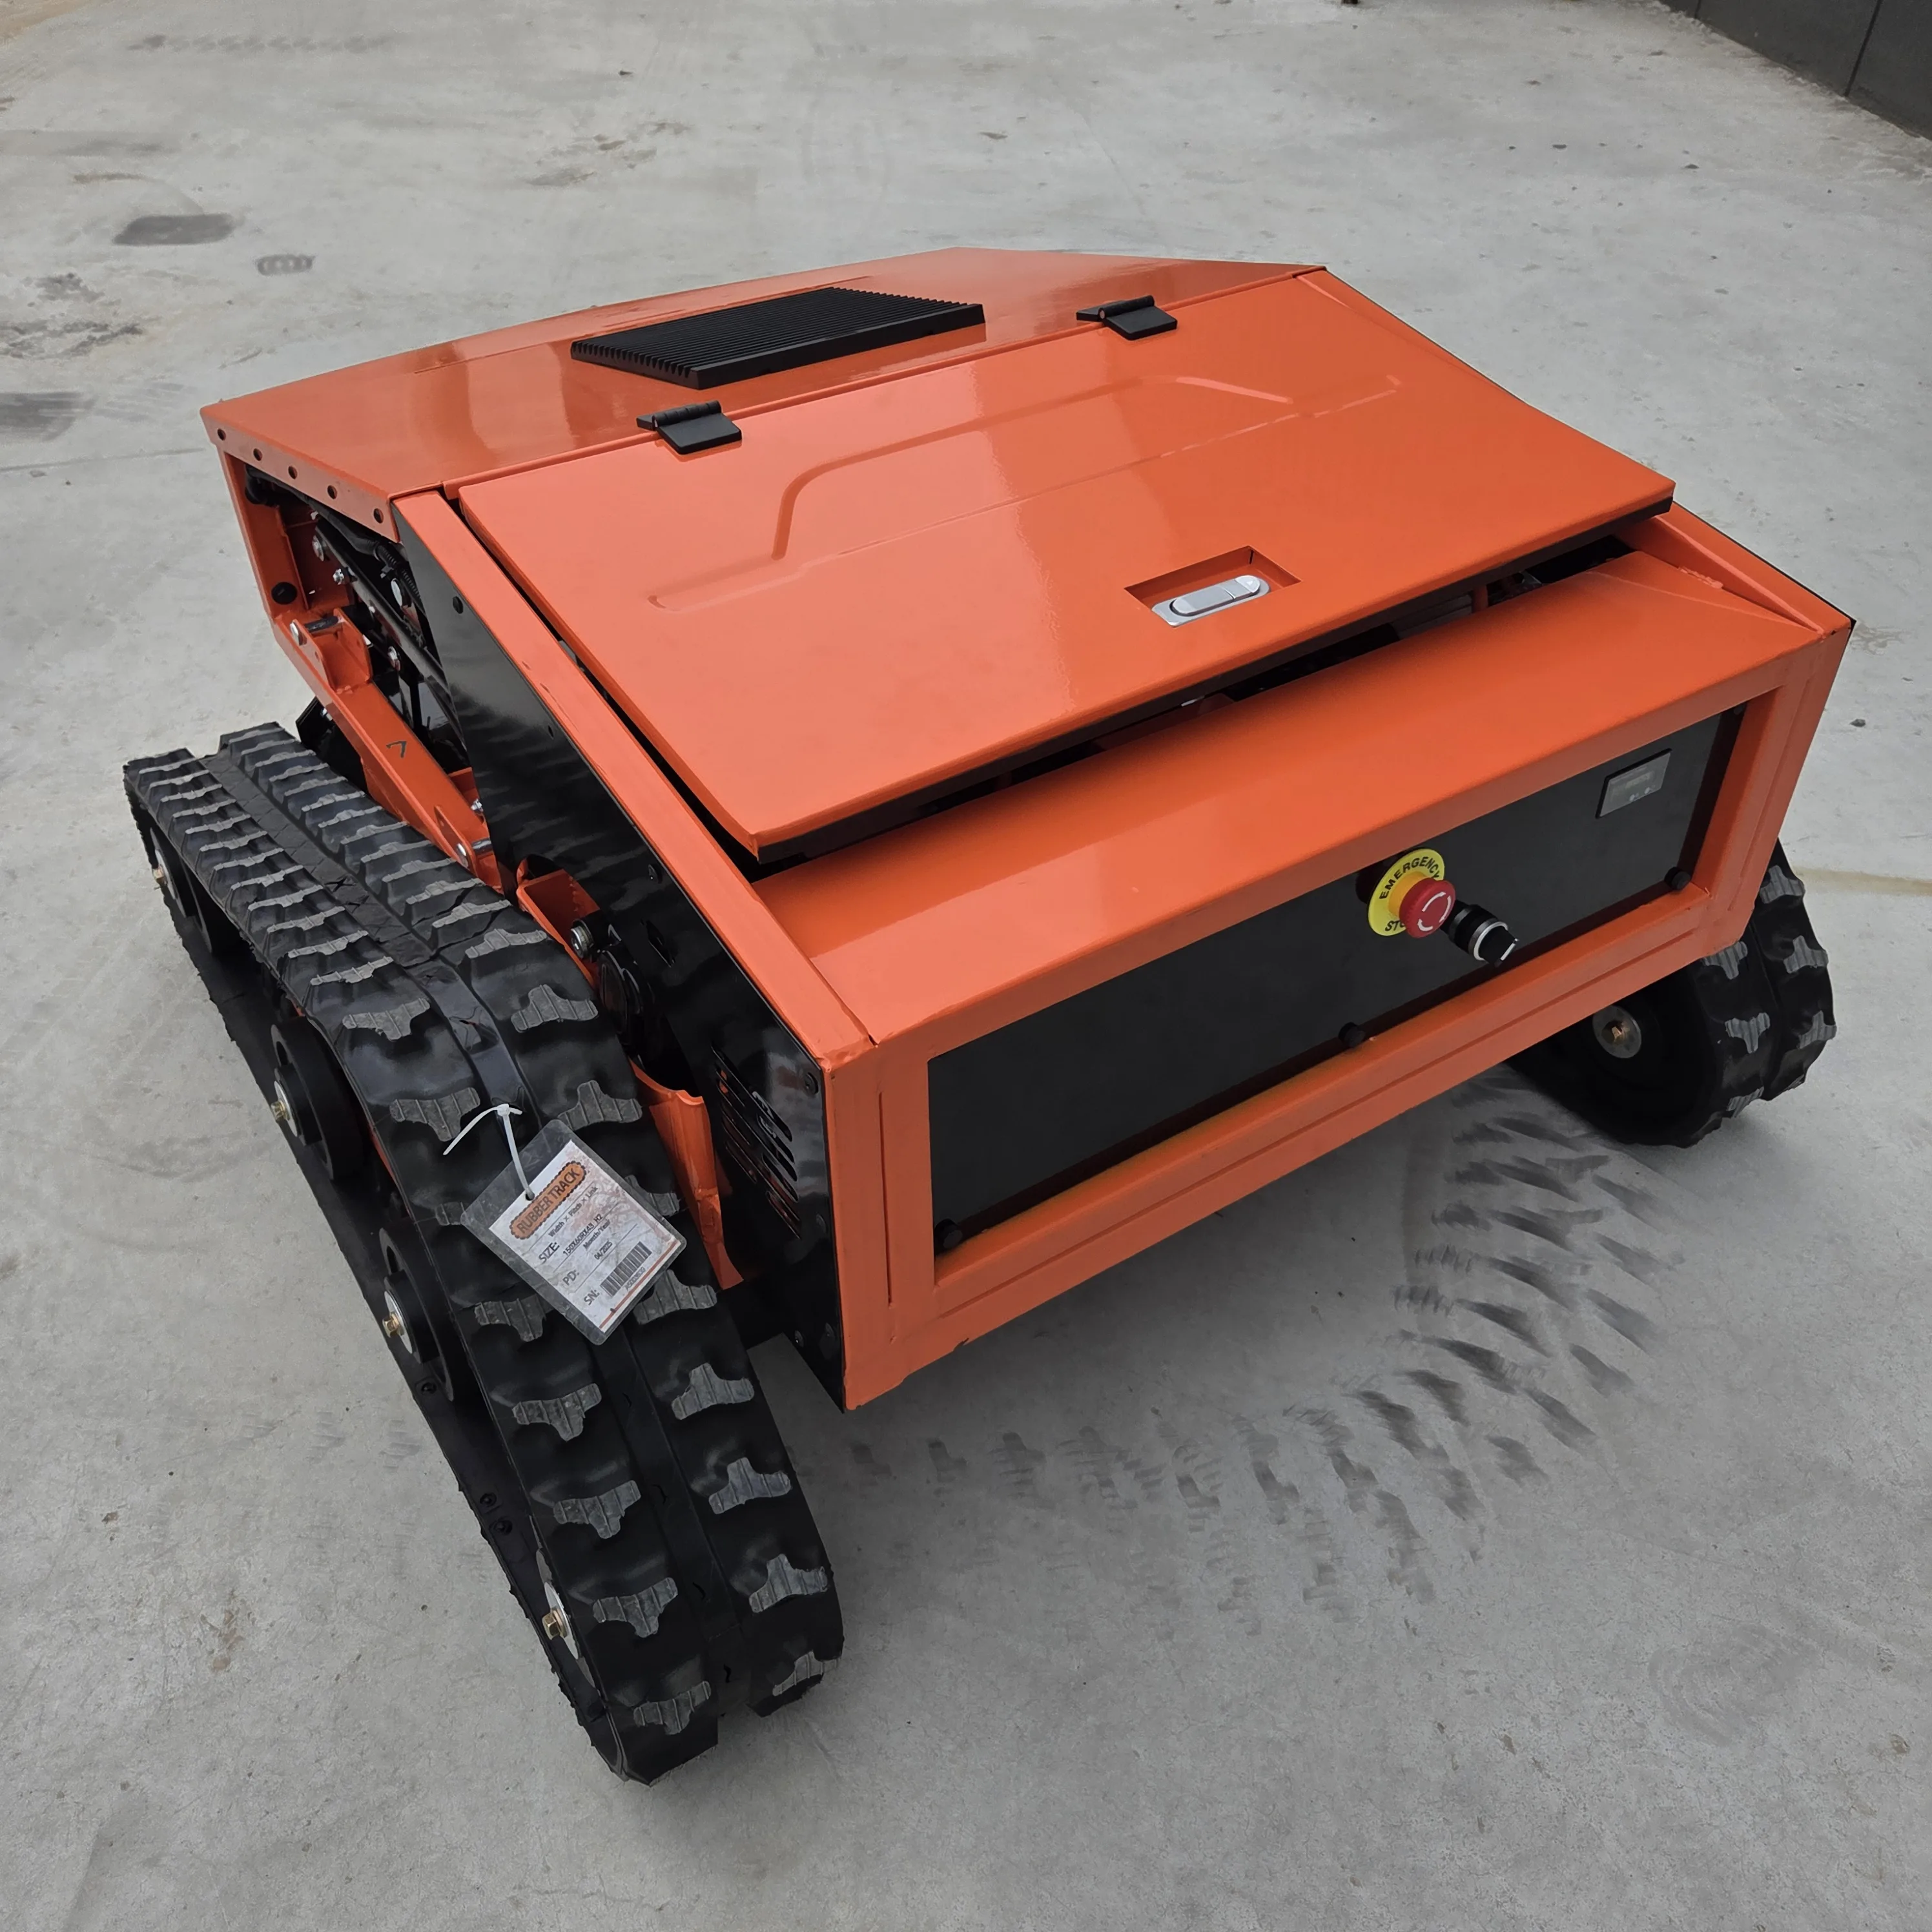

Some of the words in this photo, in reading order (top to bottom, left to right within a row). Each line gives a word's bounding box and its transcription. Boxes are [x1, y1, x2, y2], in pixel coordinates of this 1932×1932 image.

[1379, 856, 1439, 899] EMERGENCY
[516, 1196, 553, 1234] RUBBER
[548, 1168, 580, 1199] TRACK
[548, 1220, 564, 1237] Width
[586, 1186, 598, 1198] Link
[538, 1241, 560, 1263] SIZE:
[562, 1269, 580, 1286] PD:
[583, 1288, 599, 1306] SN:
